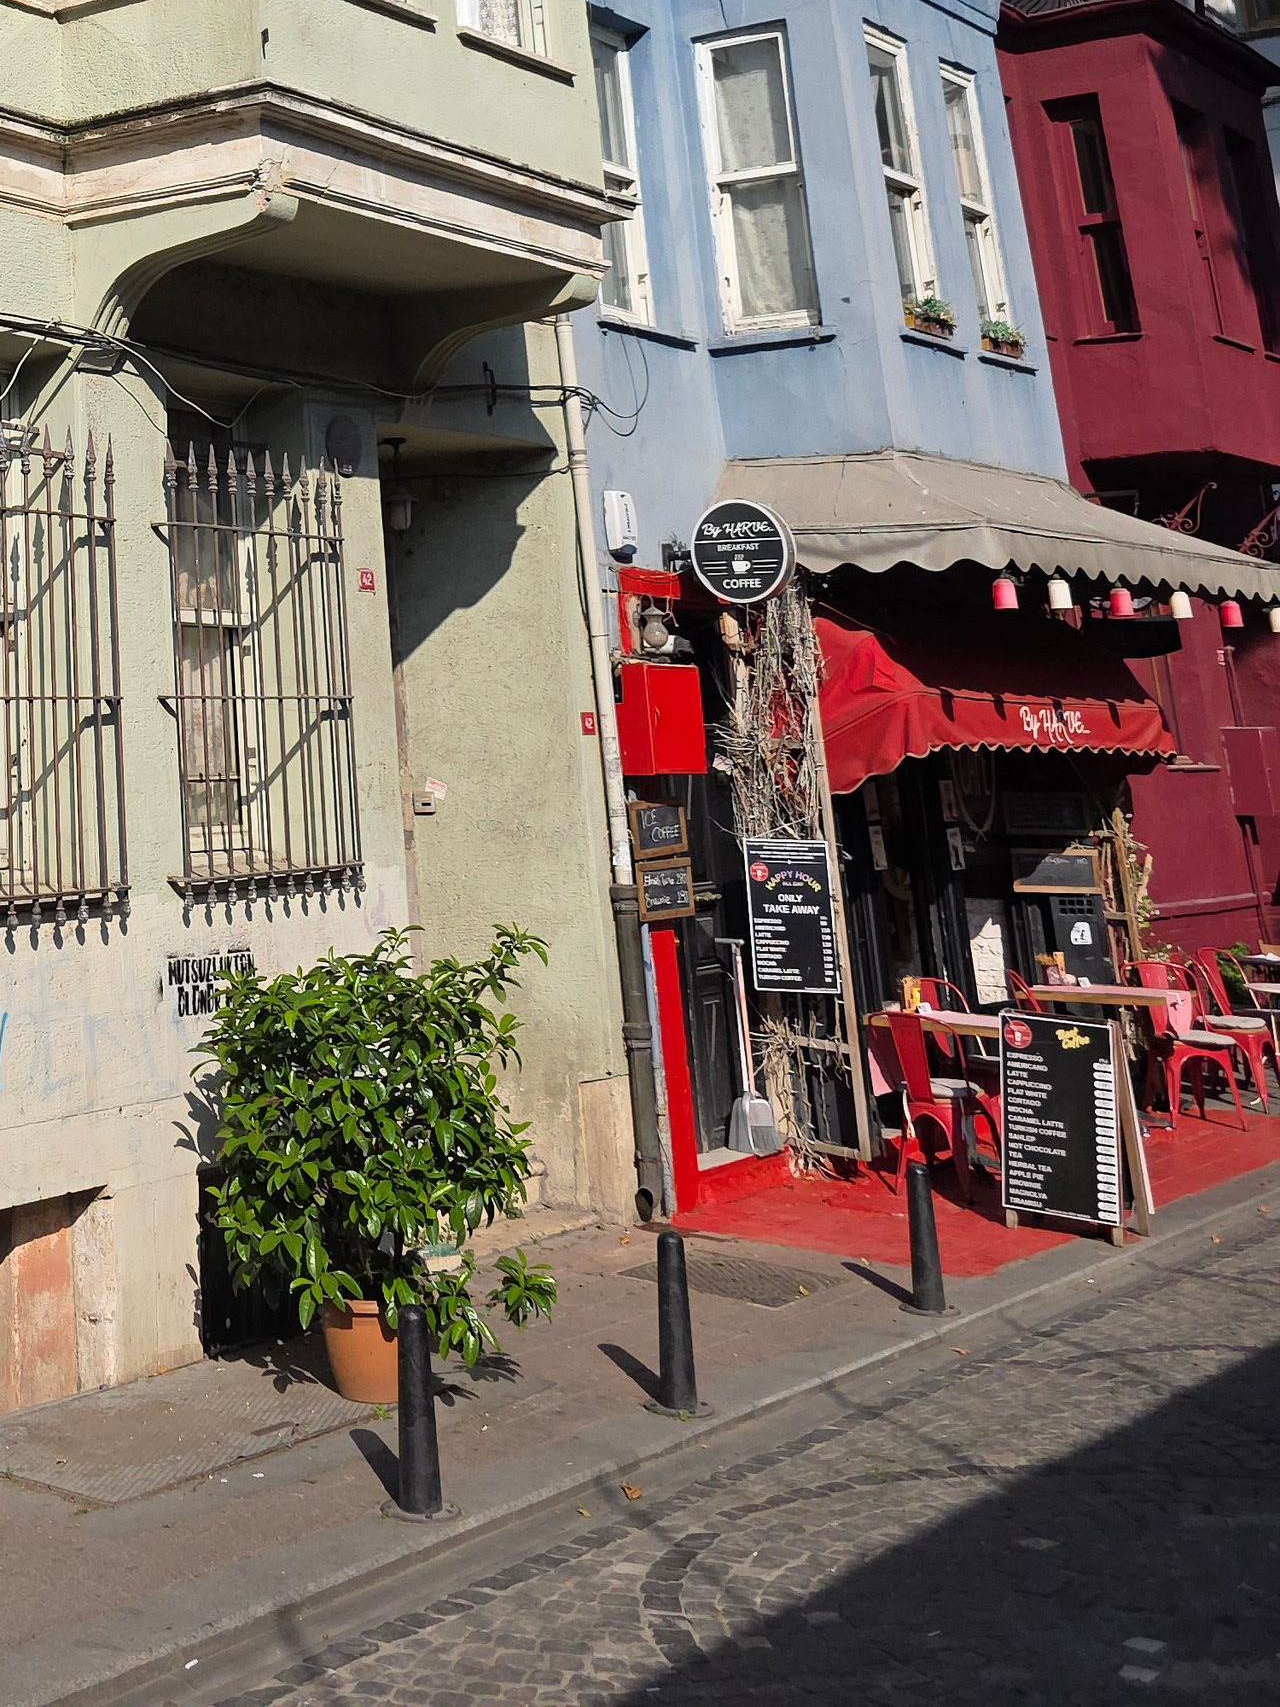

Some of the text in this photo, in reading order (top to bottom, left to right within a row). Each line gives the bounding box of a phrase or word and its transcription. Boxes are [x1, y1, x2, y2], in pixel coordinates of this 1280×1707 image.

[701, 523, 722, 538] By
[717, 543, 760, 552] BREAKFAST
[722, 578, 762, 589] COFFEE
[765, 870, 793, 891] HAPPY
[795, 871, 822, 892] HOUR
[778, 893, 803, 903] ONLY
[763, 903, 820, 915] TAKE AWAY
[1006, 1051, 1044, 1062] ESPRESSO
[1006, 1060, 1048, 1072] AMERICANO
[1006, 1070, 1028, 1078] LATTE
[1007, 1079, 1052, 1091] CAPPUCCINO
[1042, 1119, 1064, 1129] LATTE
[1039, 1128, 1067, 1139] COFFEE
[1008, 1142, 1067, 1157] HOT CHOCOLATE
[1008, 1150, 1023, 1159] TEA
[1038, 1164, 1053, 1173] TEA
